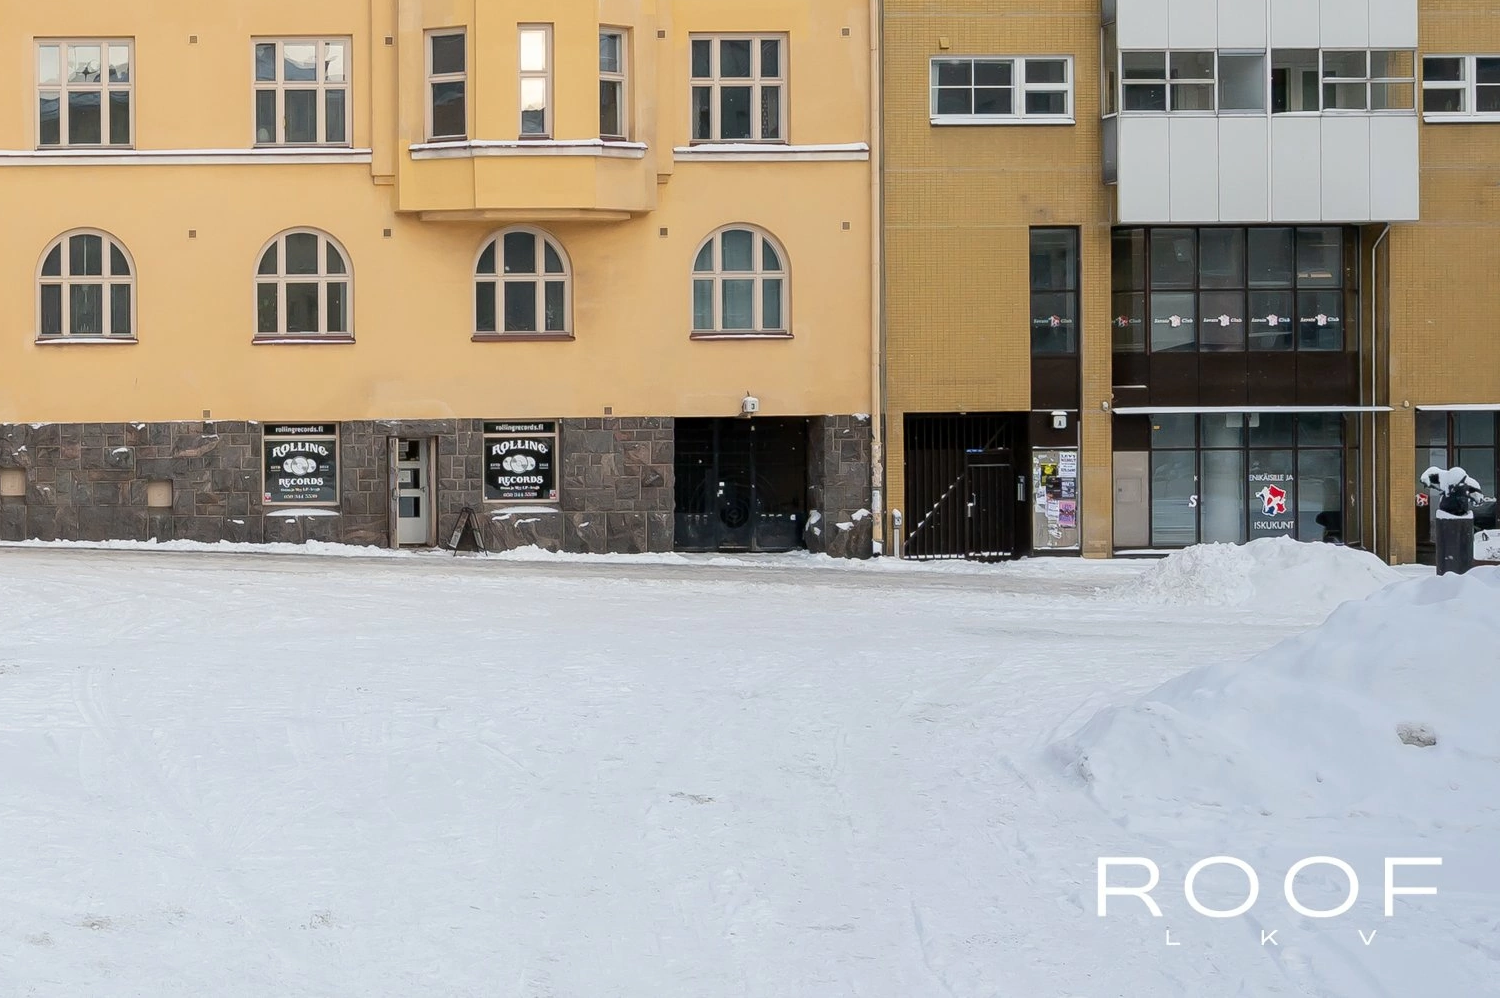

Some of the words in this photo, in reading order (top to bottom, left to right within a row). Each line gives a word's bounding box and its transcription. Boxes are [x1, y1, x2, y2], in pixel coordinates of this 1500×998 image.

[275, 426, 323, 434] rollingrecords.fi
[495, 424, 544, 432] rollingrecords.fi
[272, 442, 329, 457] ROLLING
[492, 440, 548, 455] ROLLING
[279, 477, 323, 487] RECORDS
[498, 475, 543, 486] RECORDS
